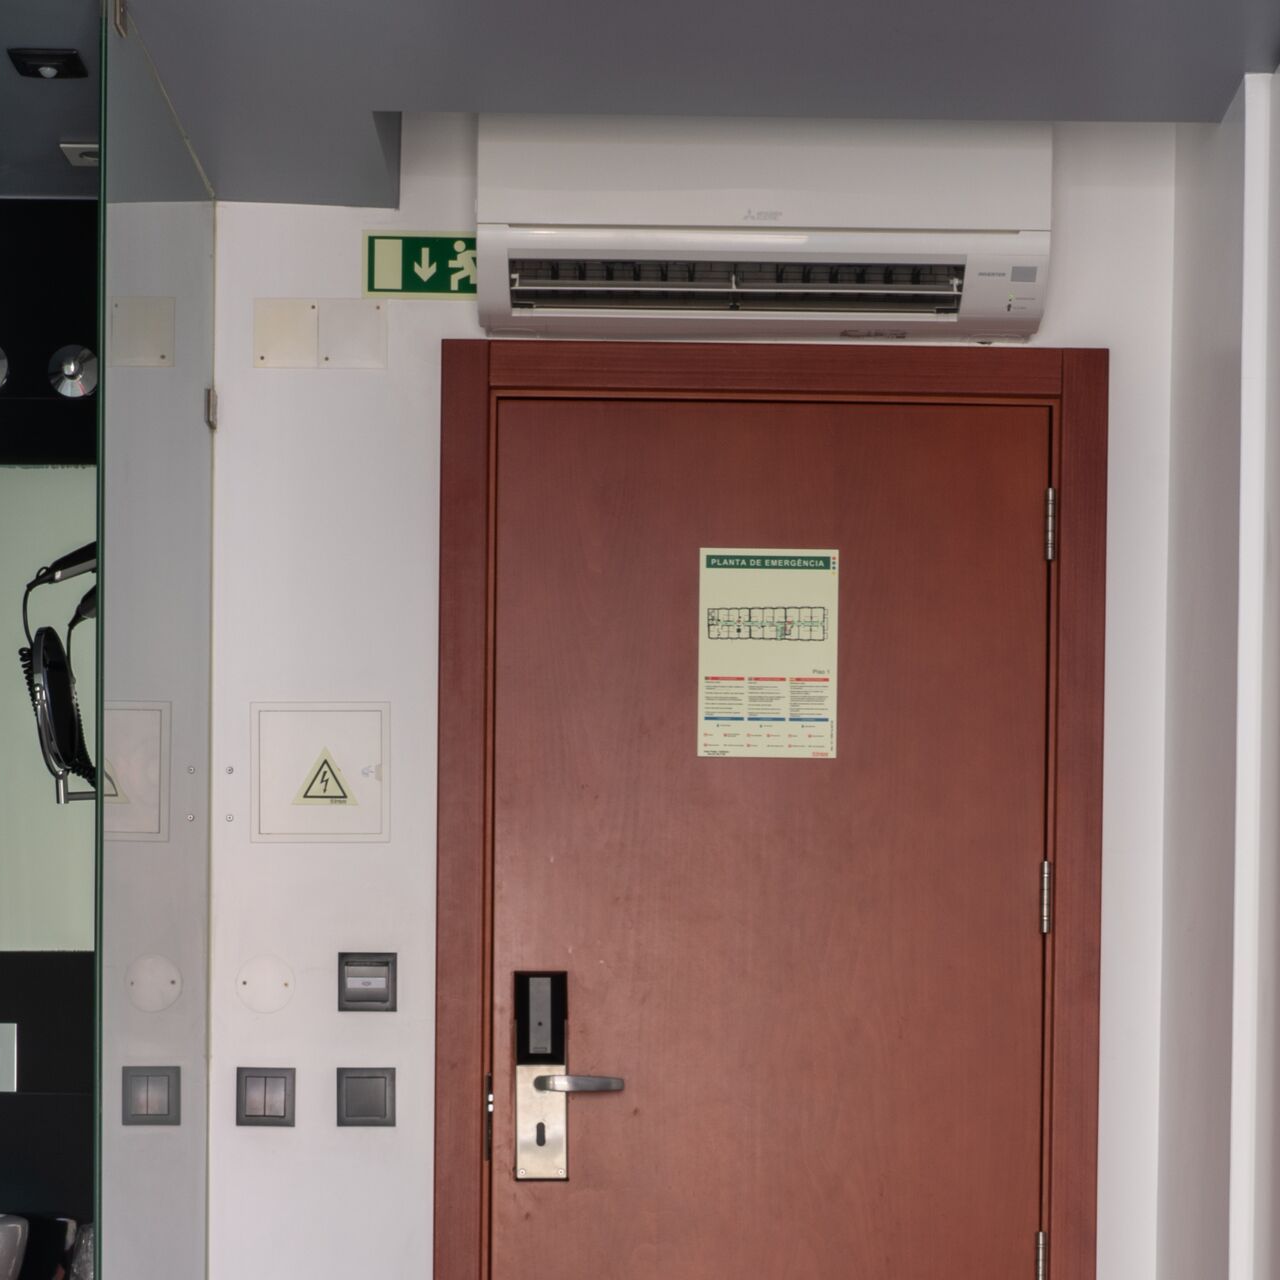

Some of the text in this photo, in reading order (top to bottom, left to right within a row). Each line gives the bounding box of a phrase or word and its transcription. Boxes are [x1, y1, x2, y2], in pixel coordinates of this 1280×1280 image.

[711, 558, 825, 568] PLANTA DE EMERGÊNCIA
